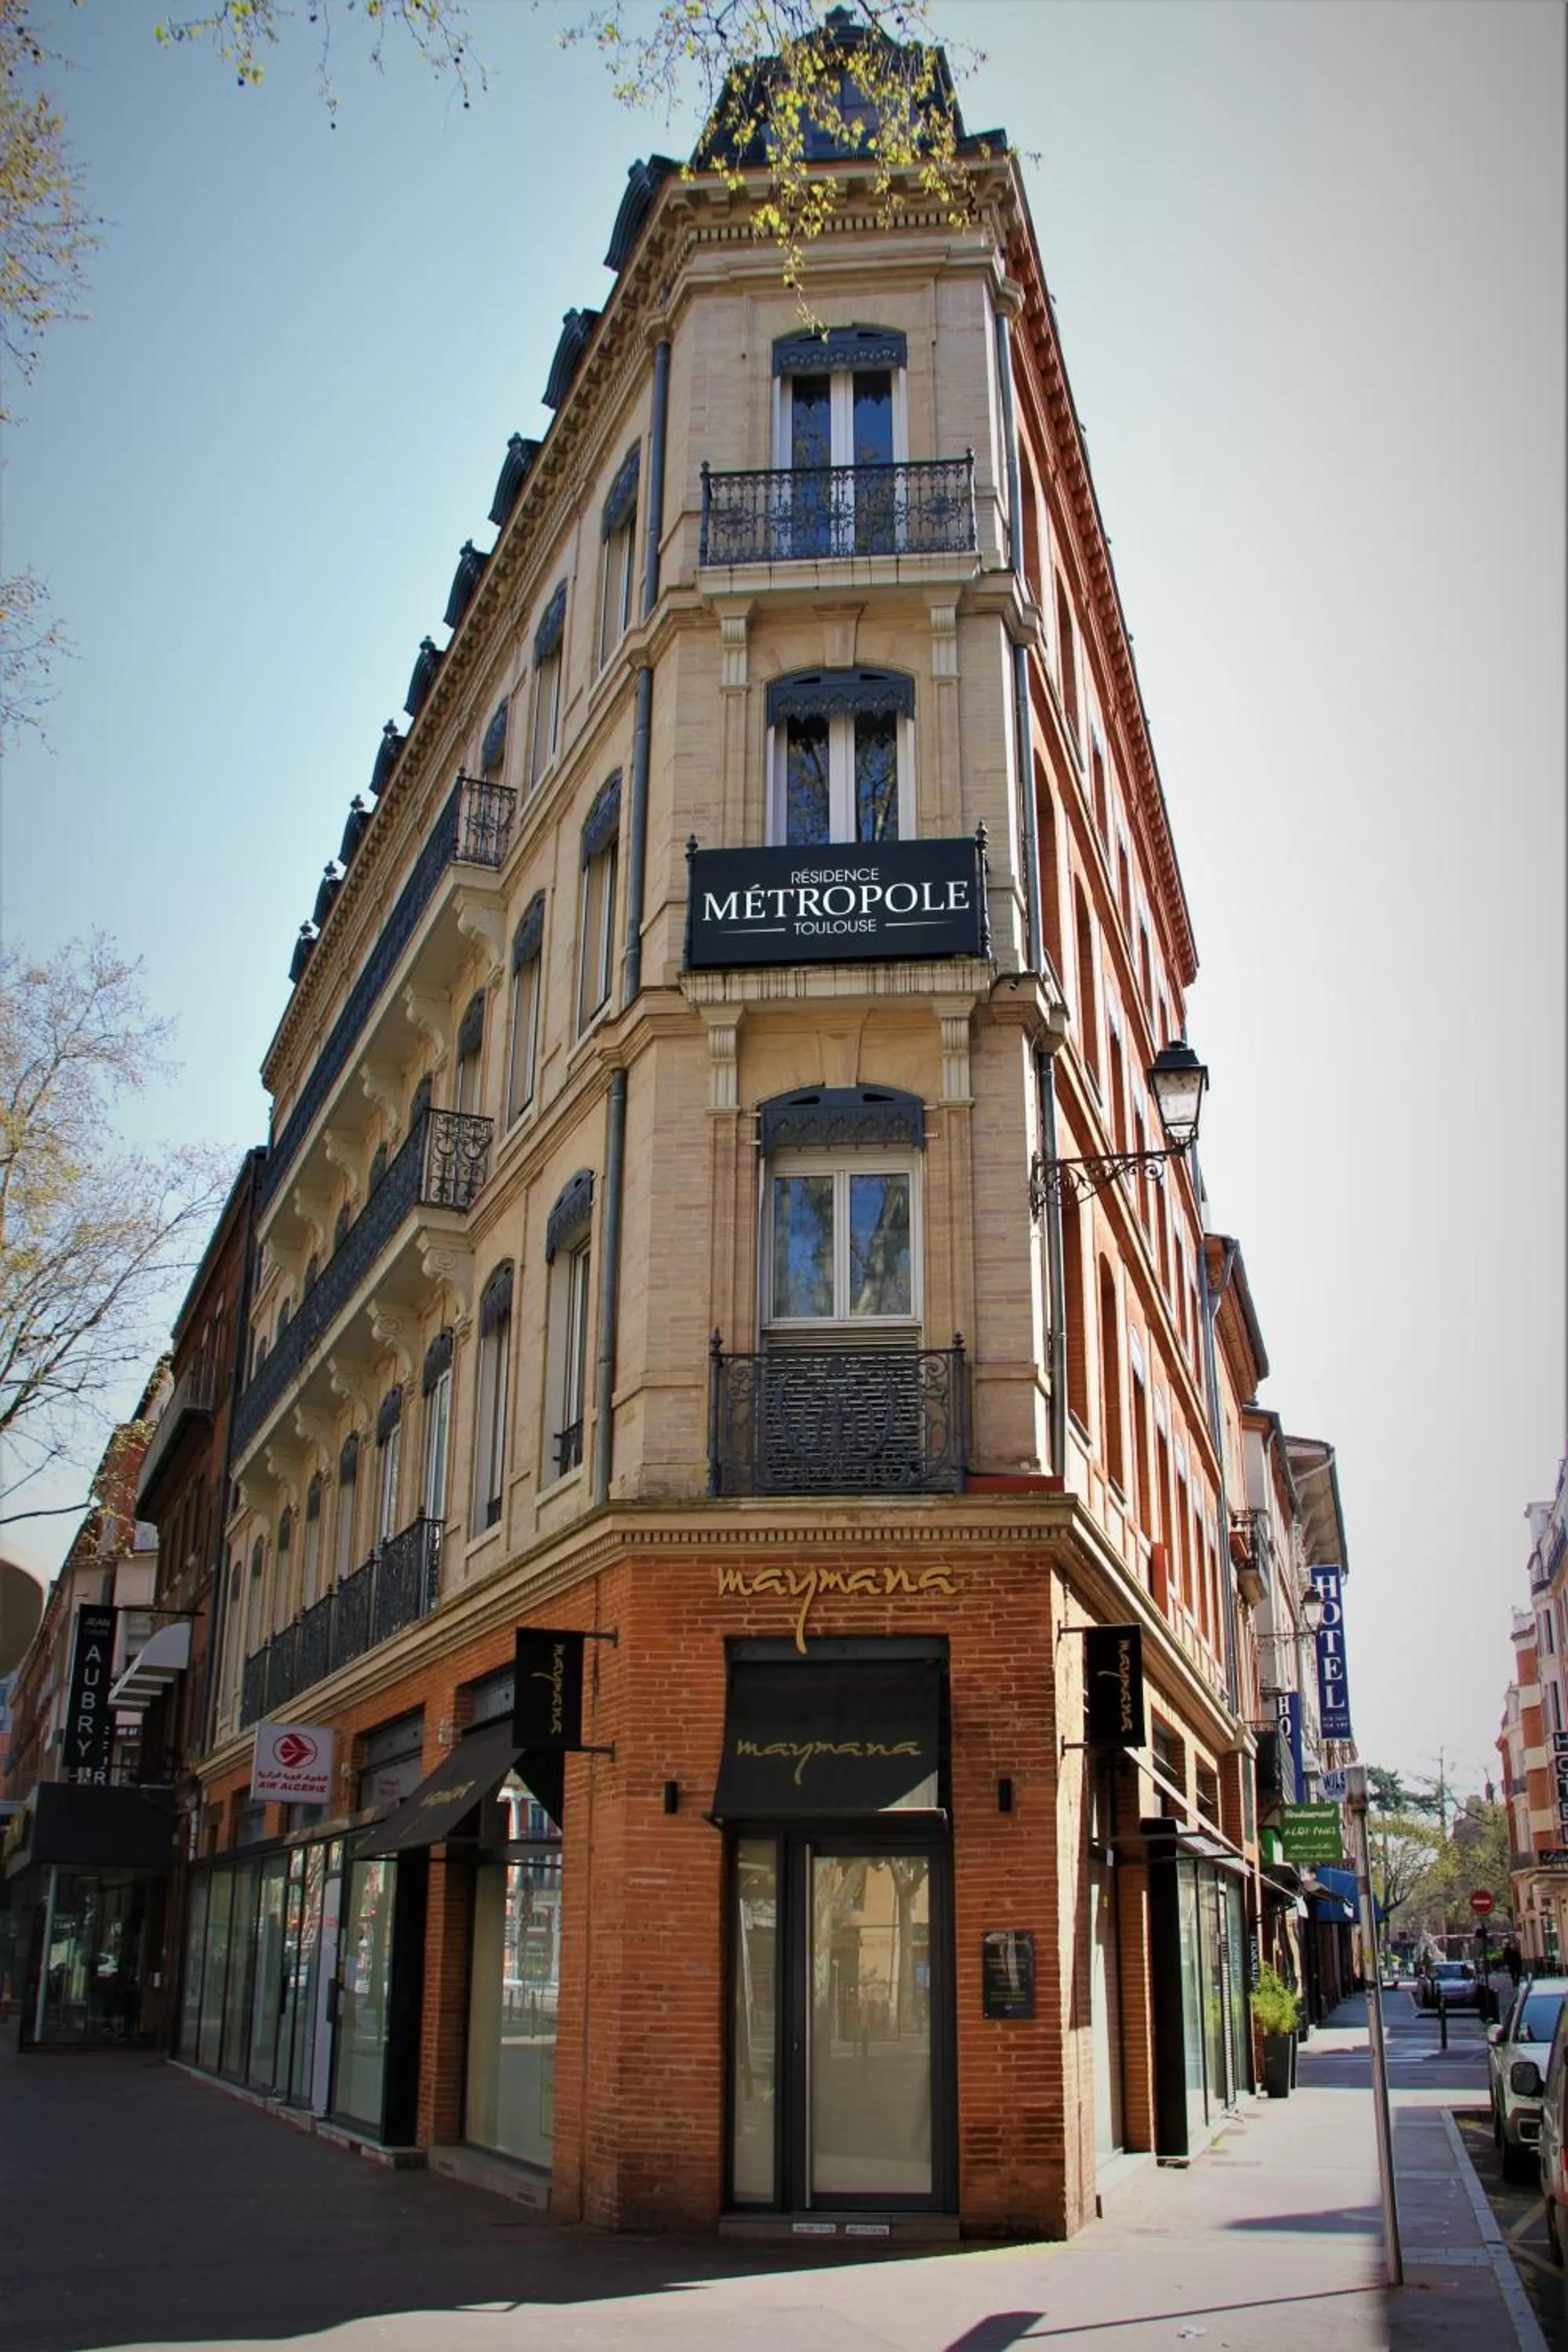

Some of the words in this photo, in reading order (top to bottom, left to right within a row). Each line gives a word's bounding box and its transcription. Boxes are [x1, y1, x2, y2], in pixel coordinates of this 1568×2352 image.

[790, 868, 879, 884] RÉSIDENCE
[702, 880, 971, 921] MÉTROPOLE
[793, 919, 877, 935] TOULOUSE
[717, 1565, 957, 1656] maymana
[1313, 1575, 1345, 1709] HOTEL
[76, 1644, 102, 1758] AUBRY
[736, 1739, 924, 1786] maymana
